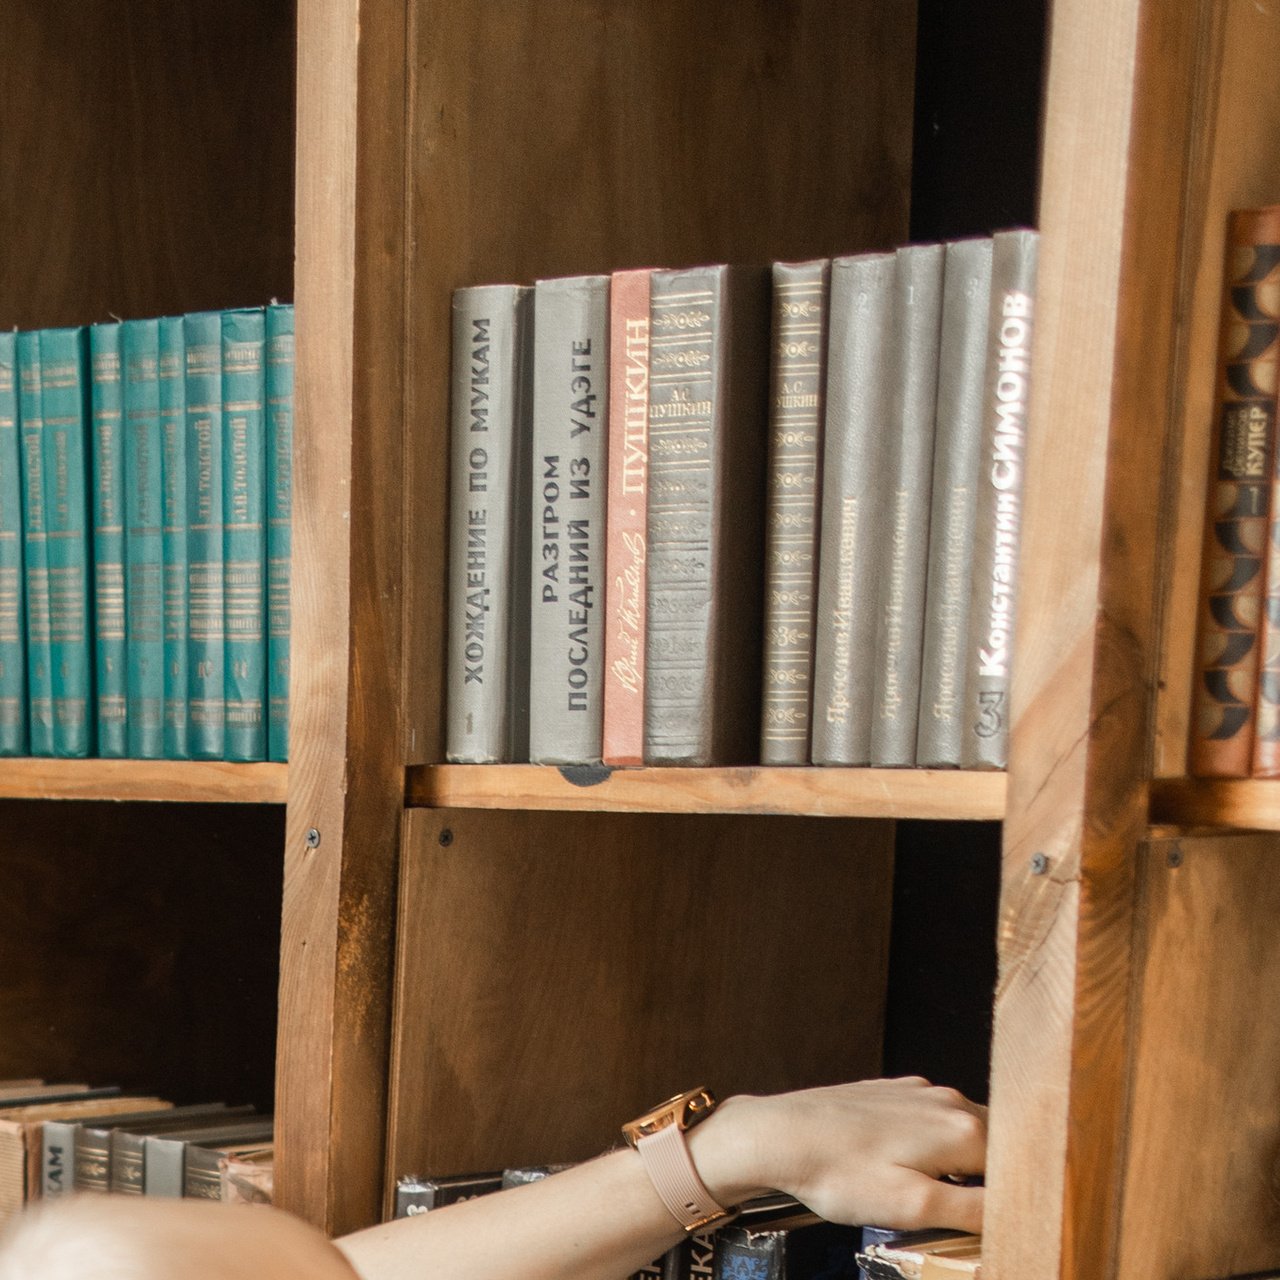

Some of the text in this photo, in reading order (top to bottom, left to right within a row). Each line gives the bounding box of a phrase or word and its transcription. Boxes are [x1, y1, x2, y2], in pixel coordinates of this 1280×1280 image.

[622, 316, 649, 496] ПУШКИН
[649, 401, 713, 418] ПУШКИН
[1245, 406, 1268, 476] КУПЕР
[463, 318, 491, 685] ХОЖДЕНИЕ ПО МУКАМ
[542, 454, 561, 604] РАЗГРОМ
[567, 338, 596, 712] ПОСЛЕДНИЙ ИЗ УДЭГЕ
[979, 290, 1031, 676] Константин СИМОНОВ
[611, 636, 639, 693] Юрий
[777, 626, 789, 645] 3
[826, 496, 856, 723] Ярослав Ивашкевич
[974, 691, 1003, 738] 3
